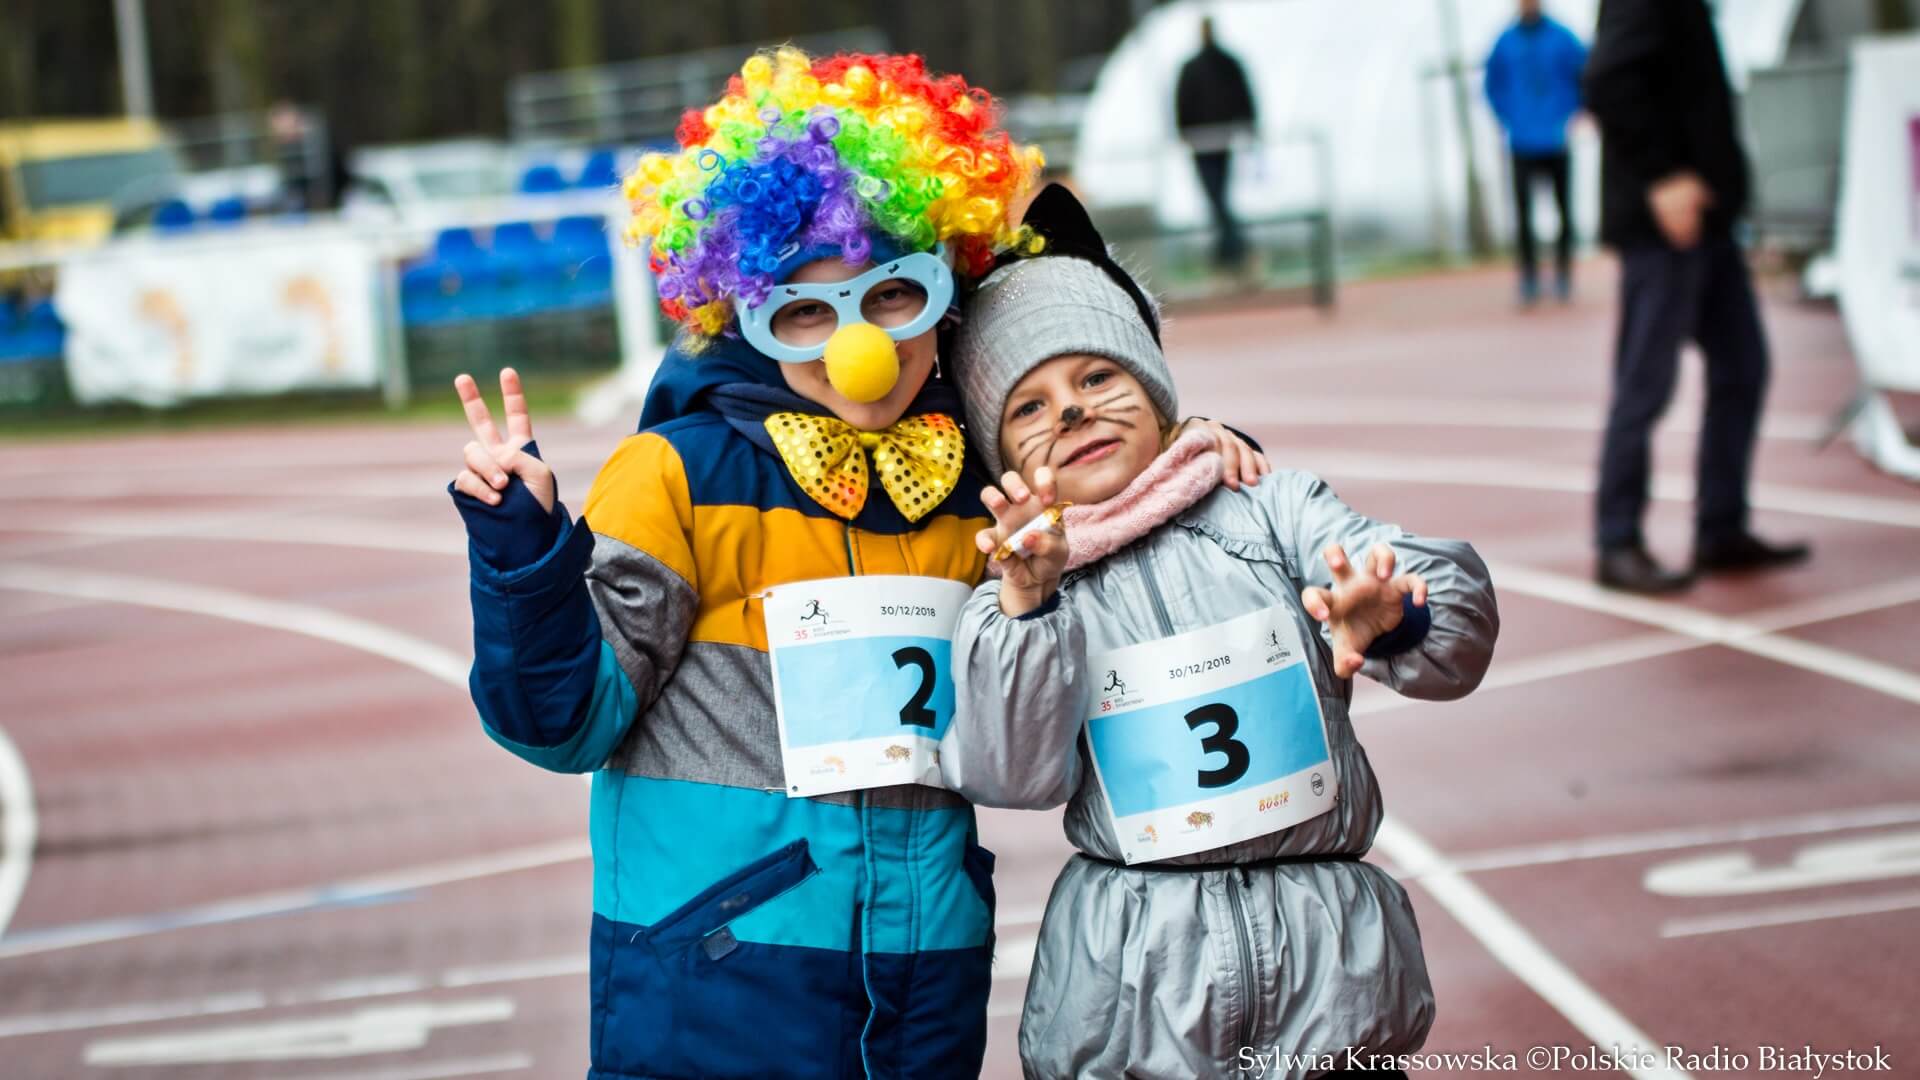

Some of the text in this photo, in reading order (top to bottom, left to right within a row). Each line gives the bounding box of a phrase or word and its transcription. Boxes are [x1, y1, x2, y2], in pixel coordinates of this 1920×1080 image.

[880, 606, 936, 618] 30/12/2018
[891, 646, 937, 729] 2
[1168, 655, 1232, 680] 30/12/2018
[1184, 703, 1250, 789] 3
